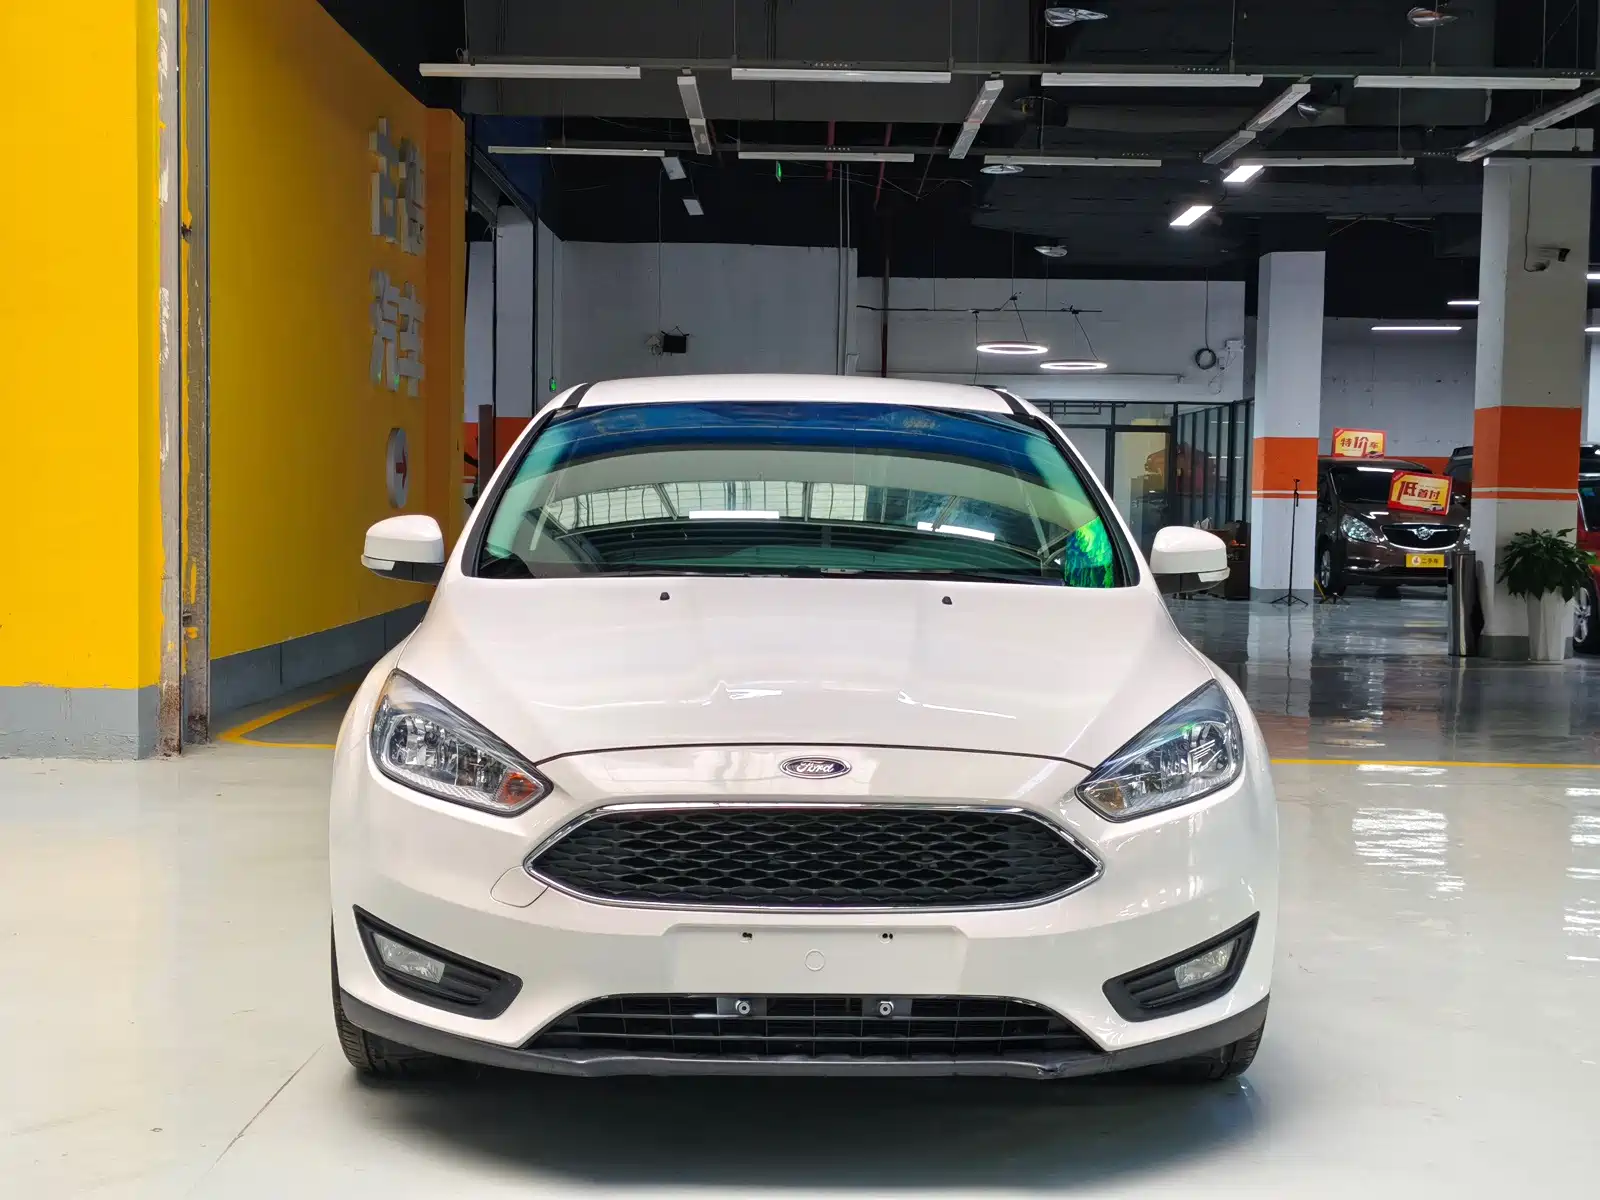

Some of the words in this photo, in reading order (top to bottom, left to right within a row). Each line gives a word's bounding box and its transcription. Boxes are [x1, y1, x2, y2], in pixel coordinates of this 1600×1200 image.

[368, 269, 425, 397] 汽车
[1340, 436, 1379, 457] 特价车
[1397, 481, 1440, 501] 低首付
[796, 761, 835, 773] Ford
